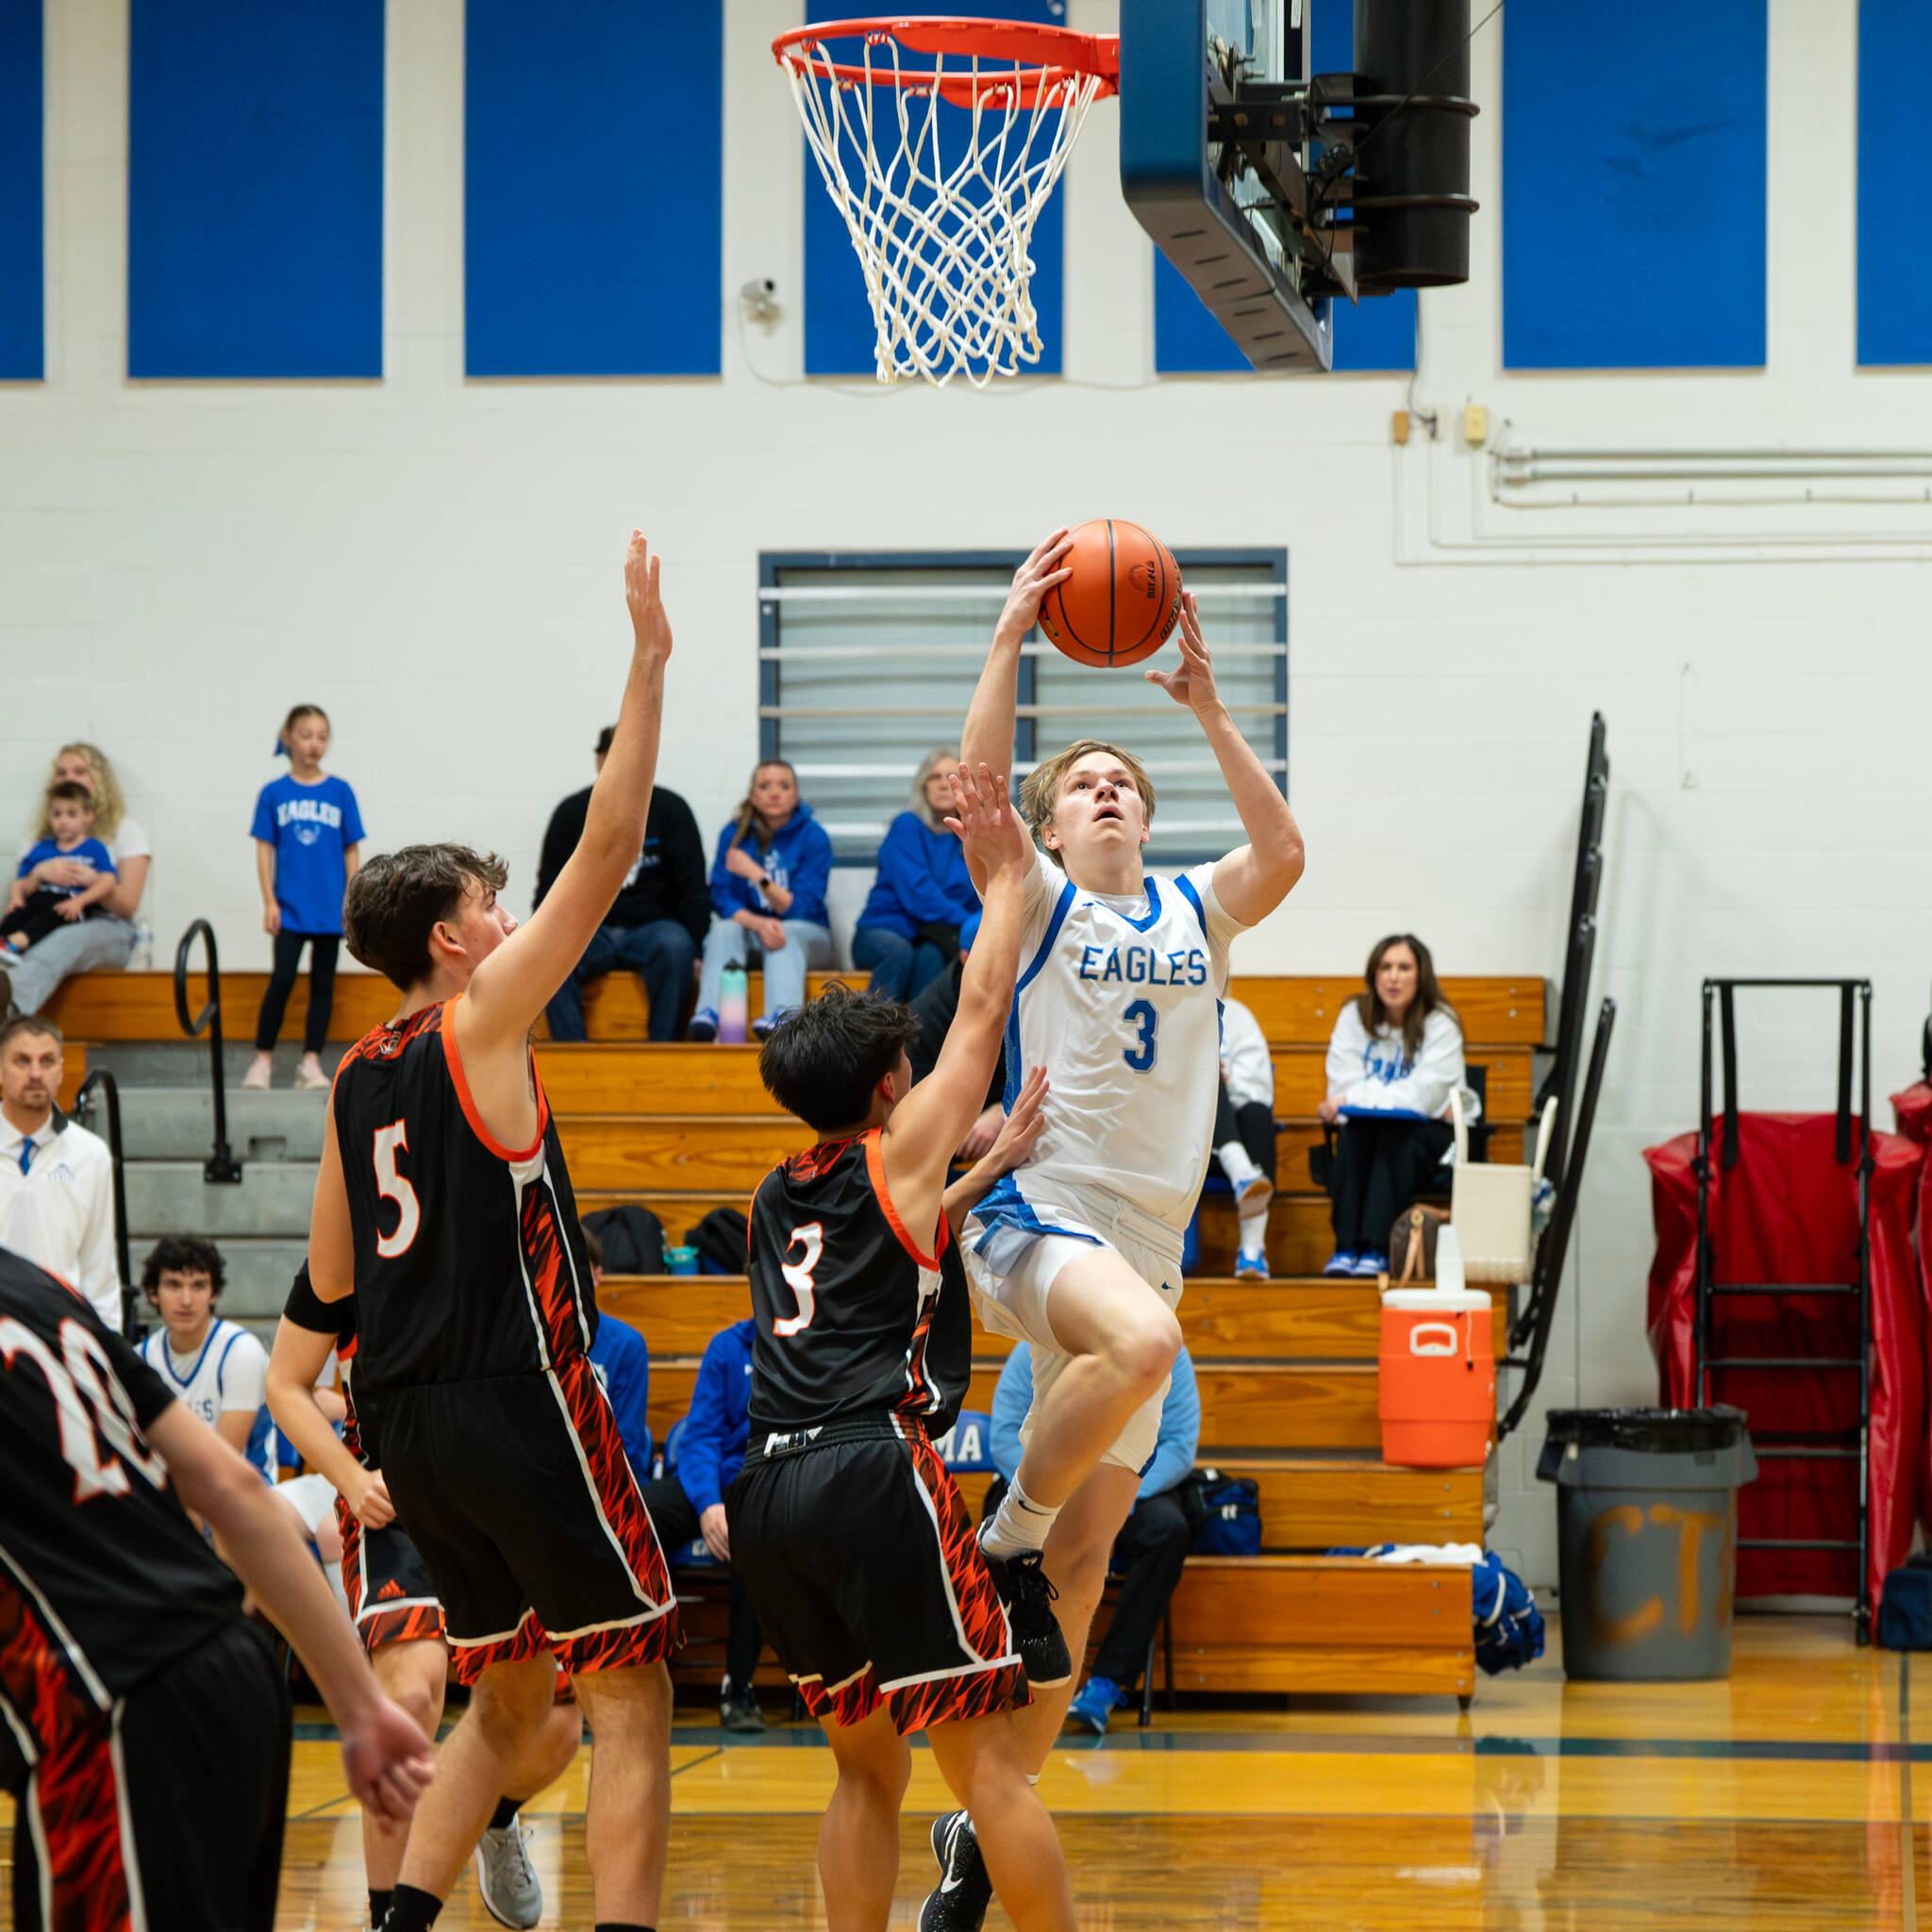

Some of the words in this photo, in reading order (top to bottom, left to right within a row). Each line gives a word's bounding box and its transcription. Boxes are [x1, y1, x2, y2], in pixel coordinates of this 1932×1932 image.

[277, 799, 341, 828] EAGLES
[1079, 944, 1207, 986] EAGLES
[1122, 997, 1159, 1074] 3
[373, 1117, 421, 1258] 5
[773, 1221, 824, 1337] 3
[1583, 1503, 1733, 1645] CT
